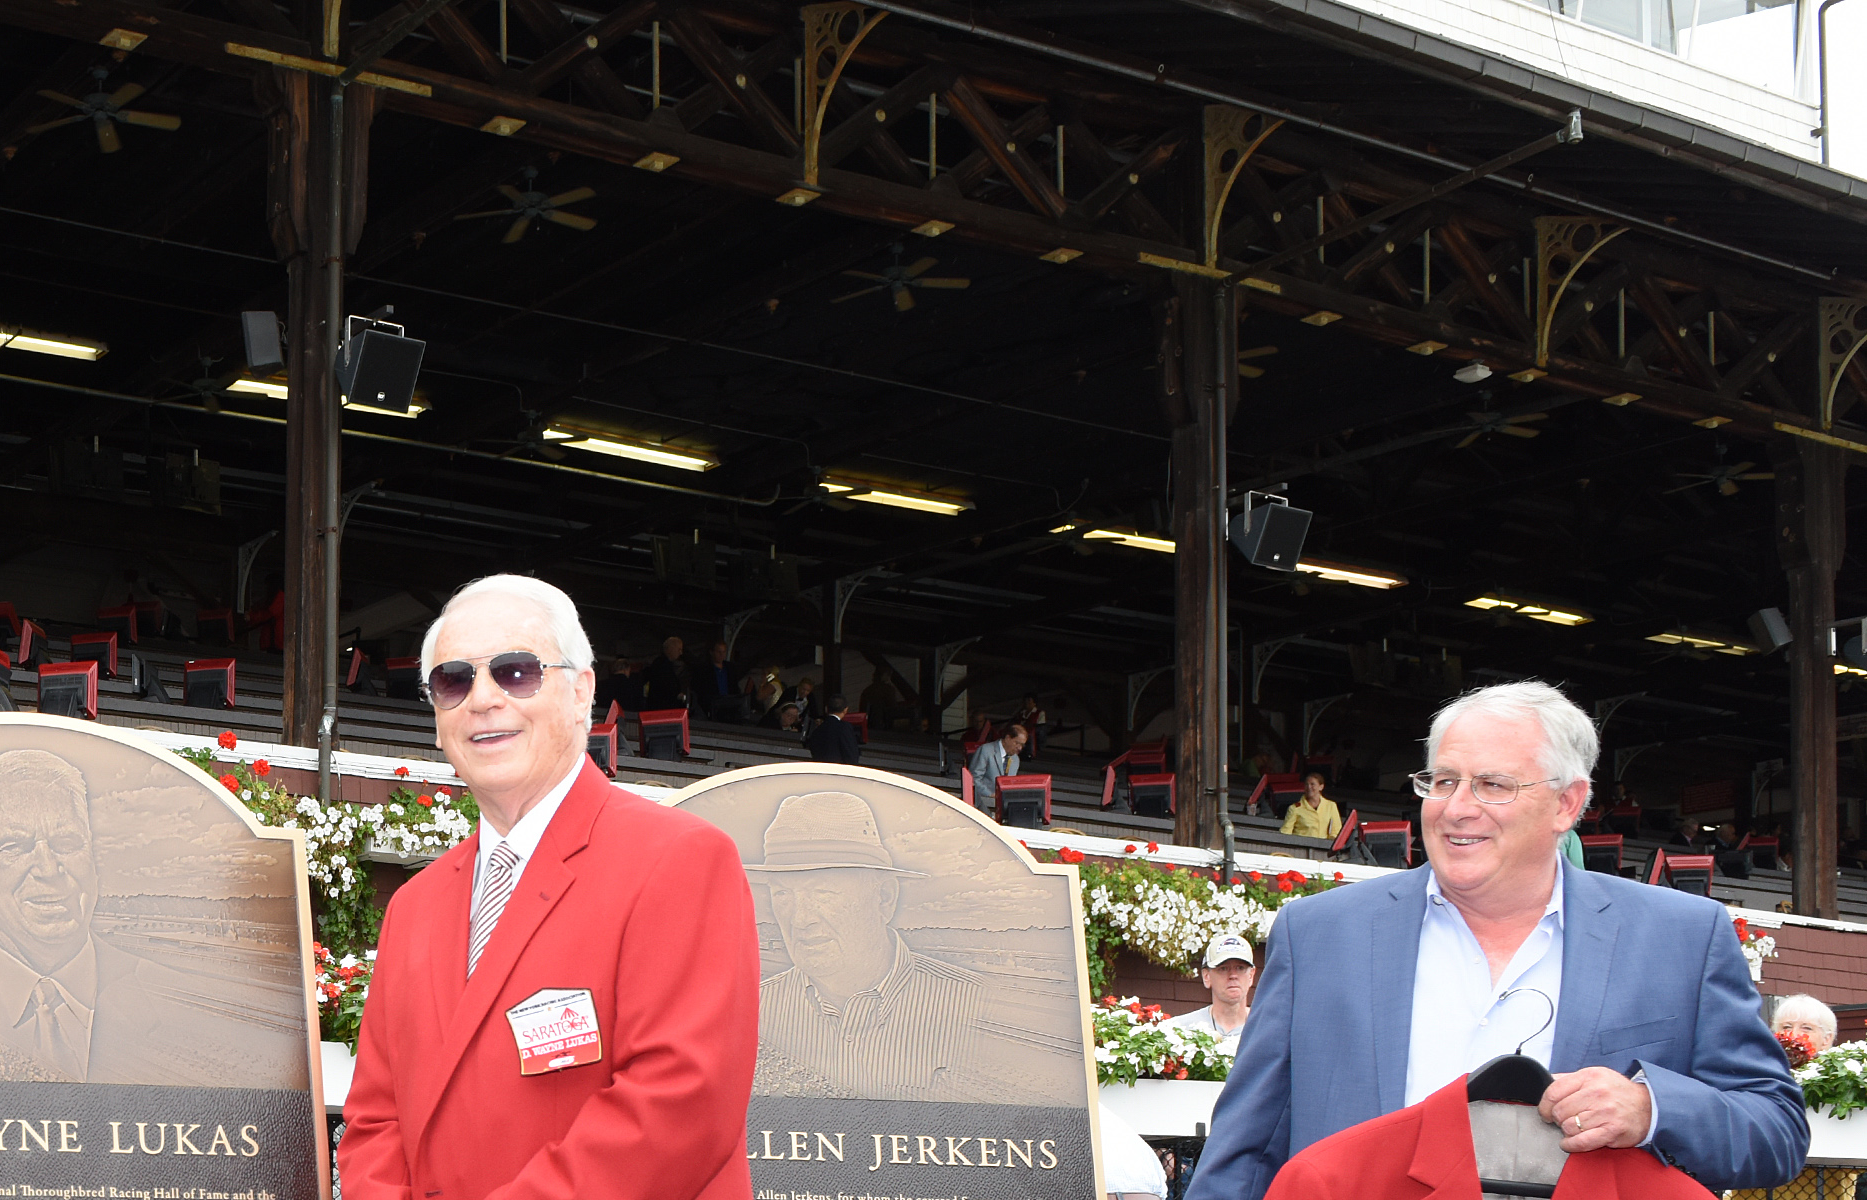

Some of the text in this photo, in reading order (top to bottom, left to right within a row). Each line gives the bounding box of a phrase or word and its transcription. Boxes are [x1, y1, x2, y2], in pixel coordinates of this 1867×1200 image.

[522, 1016, 590, 1045] SARATOGA
[532, 1041, 564, 1055] WAYNE
[566, 1033, 597, 1048] LUKAS
[109, 1121, 259, 1157] LUKAS
[868, 1134, 1058, 1171] JERKENS
[20, 1184, 105, 1200] Thoroughbred
[154, 1187, 180, 1199] Hall
[183, 1188, 196, 1199] of
[199, 1188, 229, 1200] Fame
[233, 1189, 254, 1200] and
[258, 1190, 275, 1200] the
[757, 1189, 787, 1200] Allen
